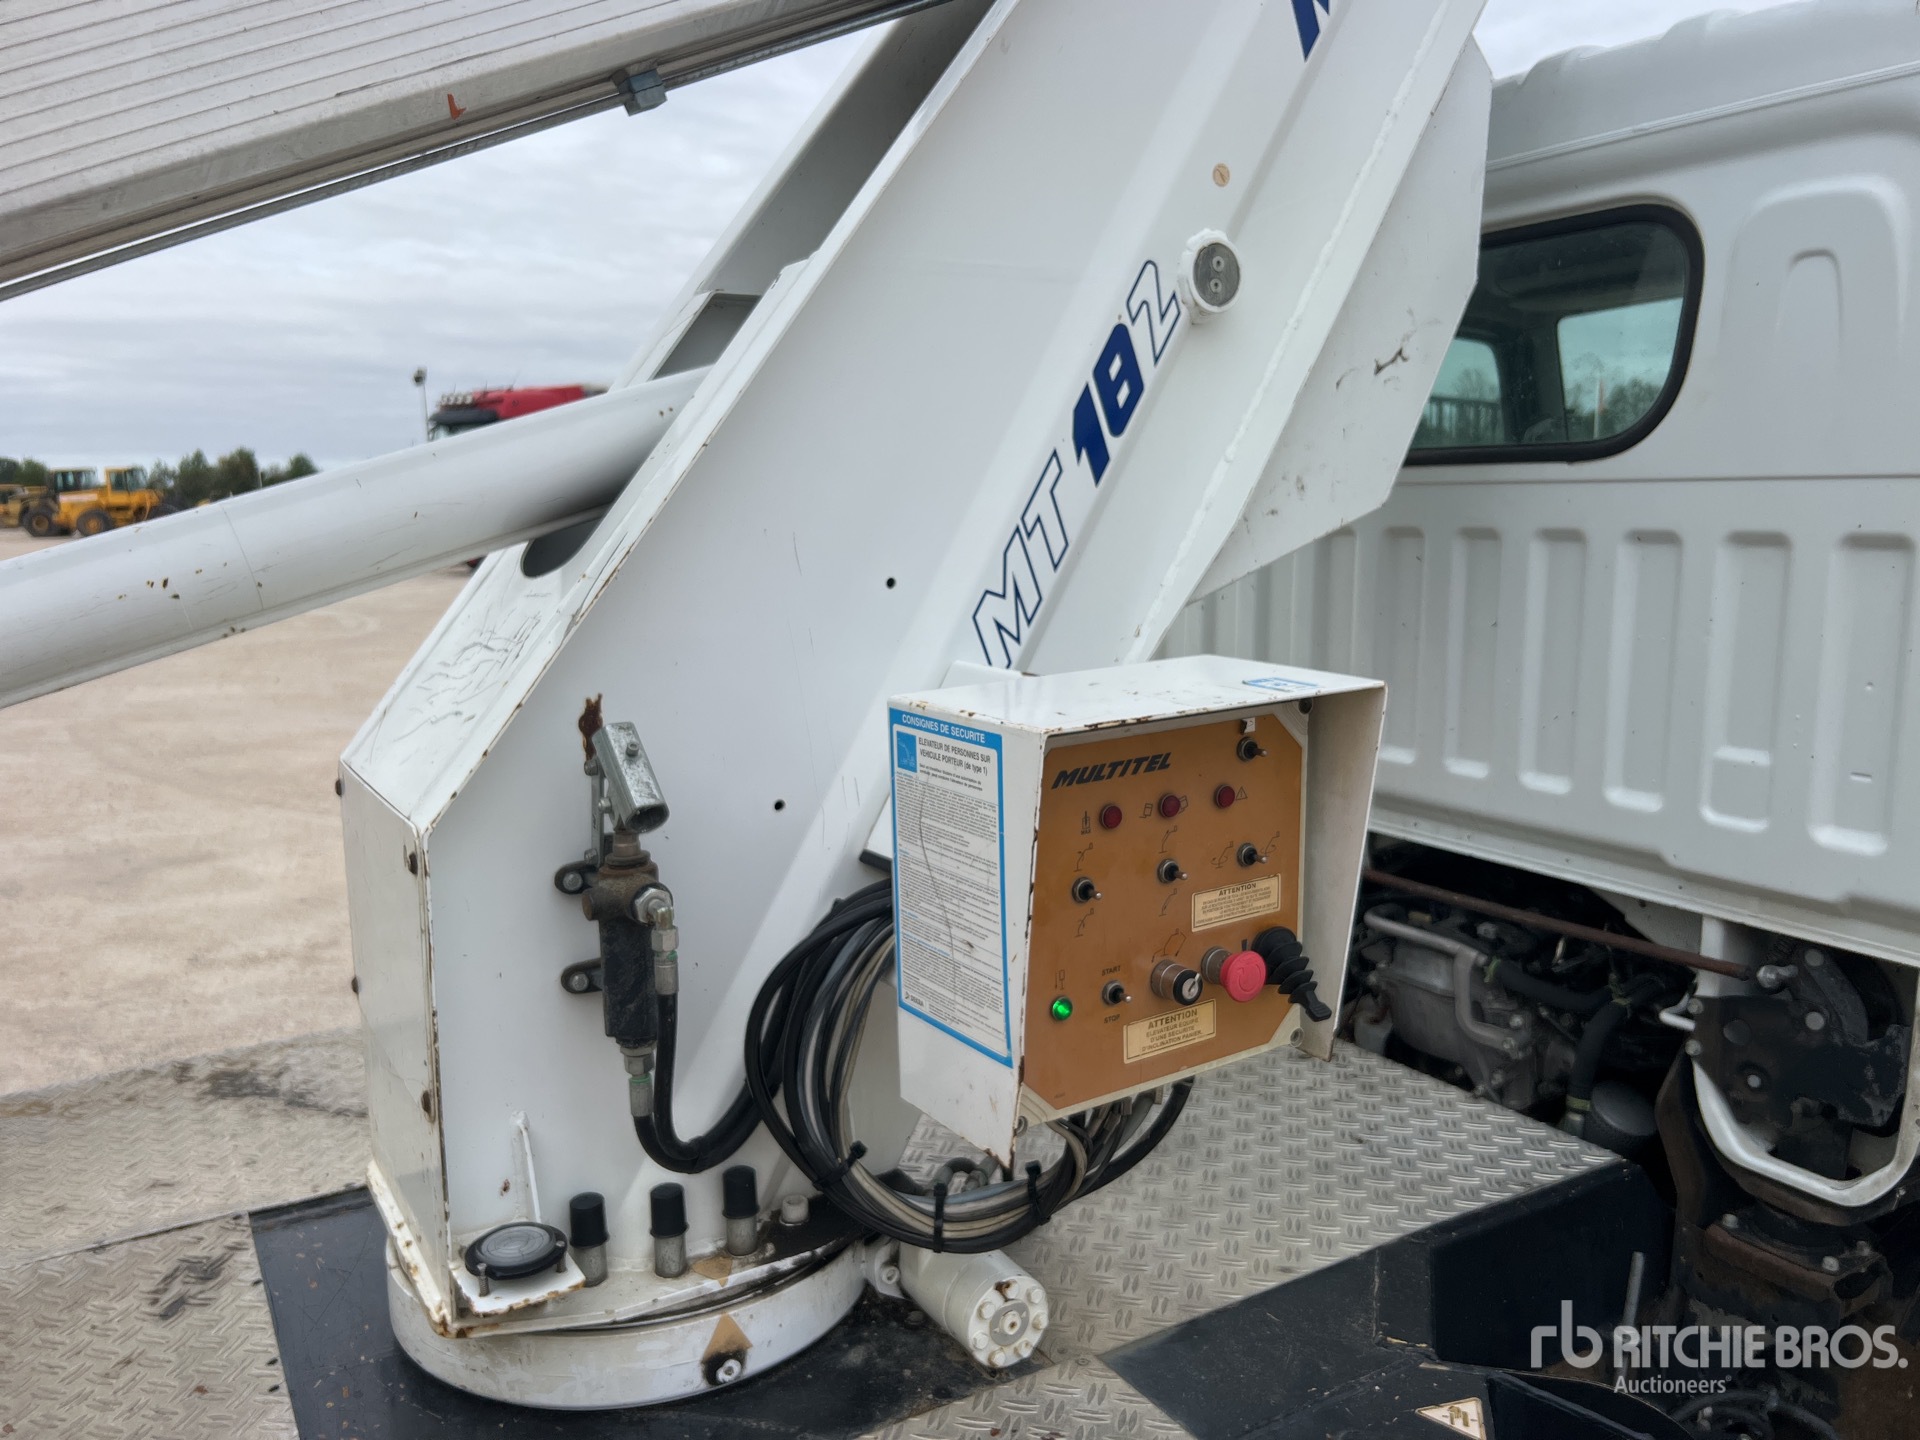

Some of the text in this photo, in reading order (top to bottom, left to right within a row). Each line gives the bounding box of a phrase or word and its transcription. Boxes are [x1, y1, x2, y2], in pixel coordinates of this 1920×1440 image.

[973, 259, 1181, 668] MT 182
[902, 714, 986, 743] CONSIGNES DE SECURITE
[918, 737, 991, 763] ELEVATEUR DE PERSONNES SUR
[942, 754, 964, 768] PORTEUR
[1051, 752, 1171, 790] MULTITEL
[1218, 882, 1257, 896] ATTENTION
[1101, 965, 1121, 976] START
[1104, 1013, 1121, 1024] STOP
[1148, 1008, 1198, 1030] ATTENTION
[1146, 1020, 1178, 1038] ELEVATEUR
